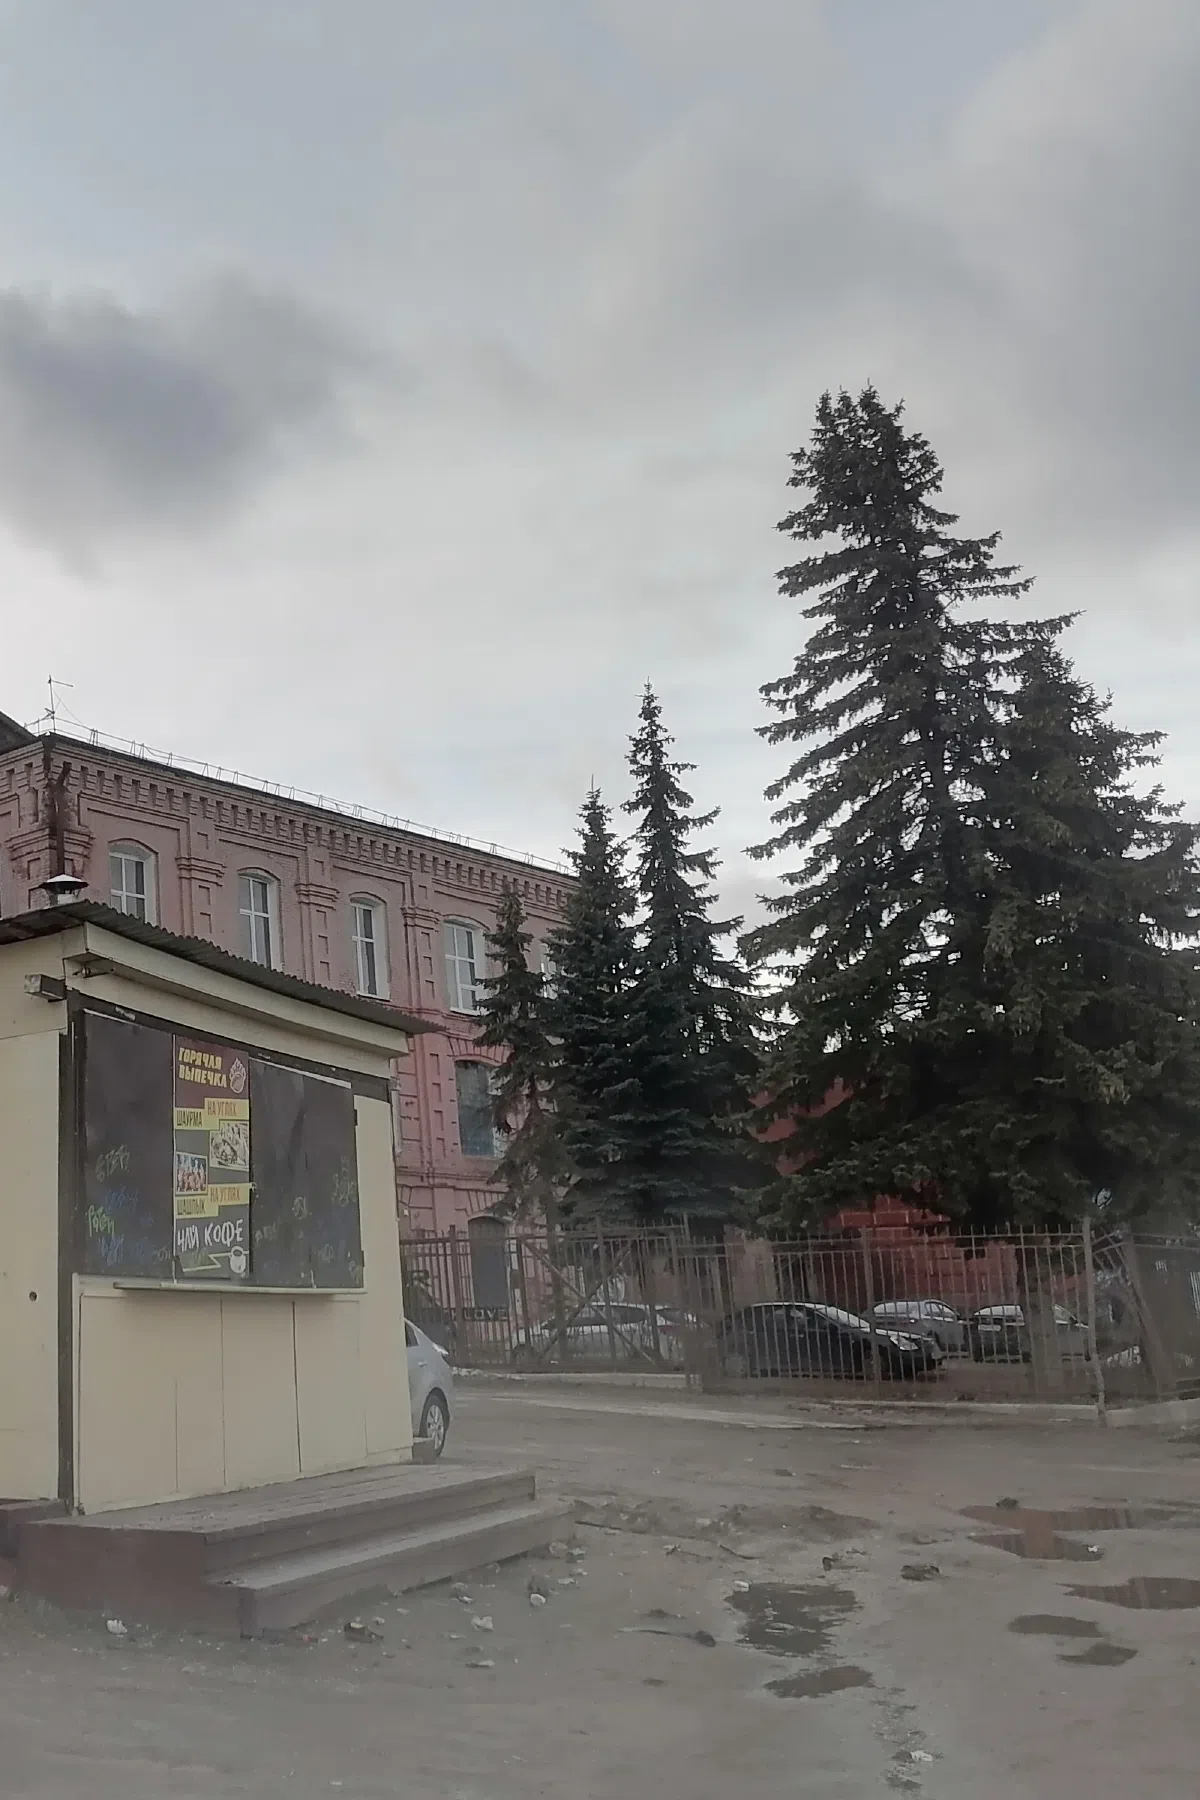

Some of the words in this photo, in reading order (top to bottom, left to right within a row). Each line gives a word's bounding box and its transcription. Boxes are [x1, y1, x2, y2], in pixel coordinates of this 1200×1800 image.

[179, 1047, 222, 1070] ГОРЯЧАЯ
[179, 1064, 228, 1088] ВЫПЕЧКА
[207, 1100, 217, 1116] НА
[217, 1100, 237, 1117] УГЛЯХ
[176, 1110, 203, 1127] ШАУРМА
[210, 1186, 219, 1203] НА
[177, 1198, 206, 1216] ШАШЛЫК
[177, 1224, 200, 1253] ЧАЙ
[204, 1219, 244, 1248] КОФЕ
